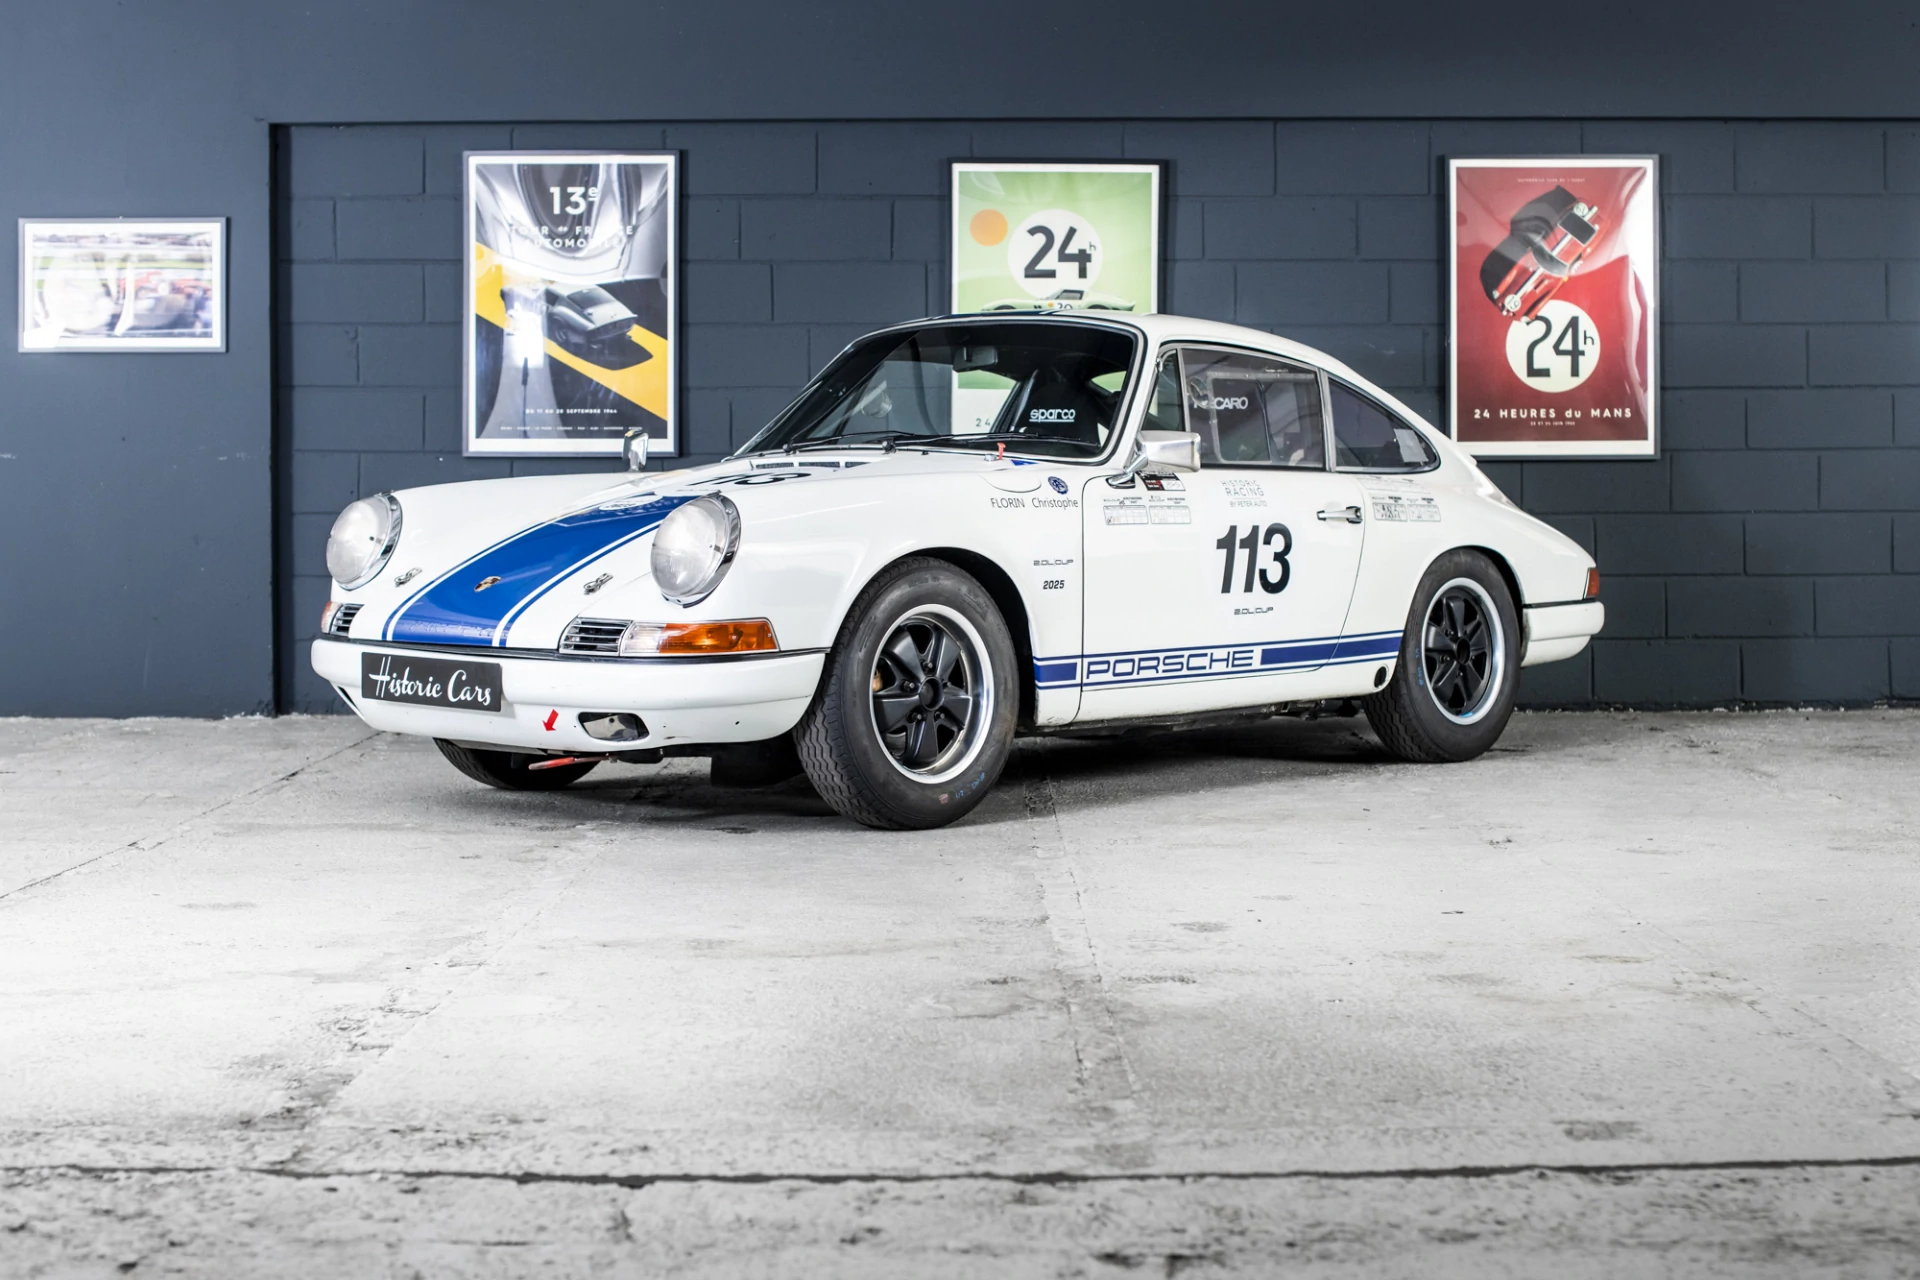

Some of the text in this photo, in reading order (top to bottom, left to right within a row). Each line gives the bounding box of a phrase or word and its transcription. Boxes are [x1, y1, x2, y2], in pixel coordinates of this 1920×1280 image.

[1030, 409, 1076, 422] sparco
[1474, 407, 1632, 419] 24 HEURES du MANS
[1225, 487, 1264, 496] RACING
[990, 497, 1079, 510] FLORIN Christophe
[1216, 522, 1293, 595] 113
[1042, 579, 1065, 590] 2025
[1086, 649, 1254, 679] PORSCHE
[368, 655, 491, 706] Historic Cars
